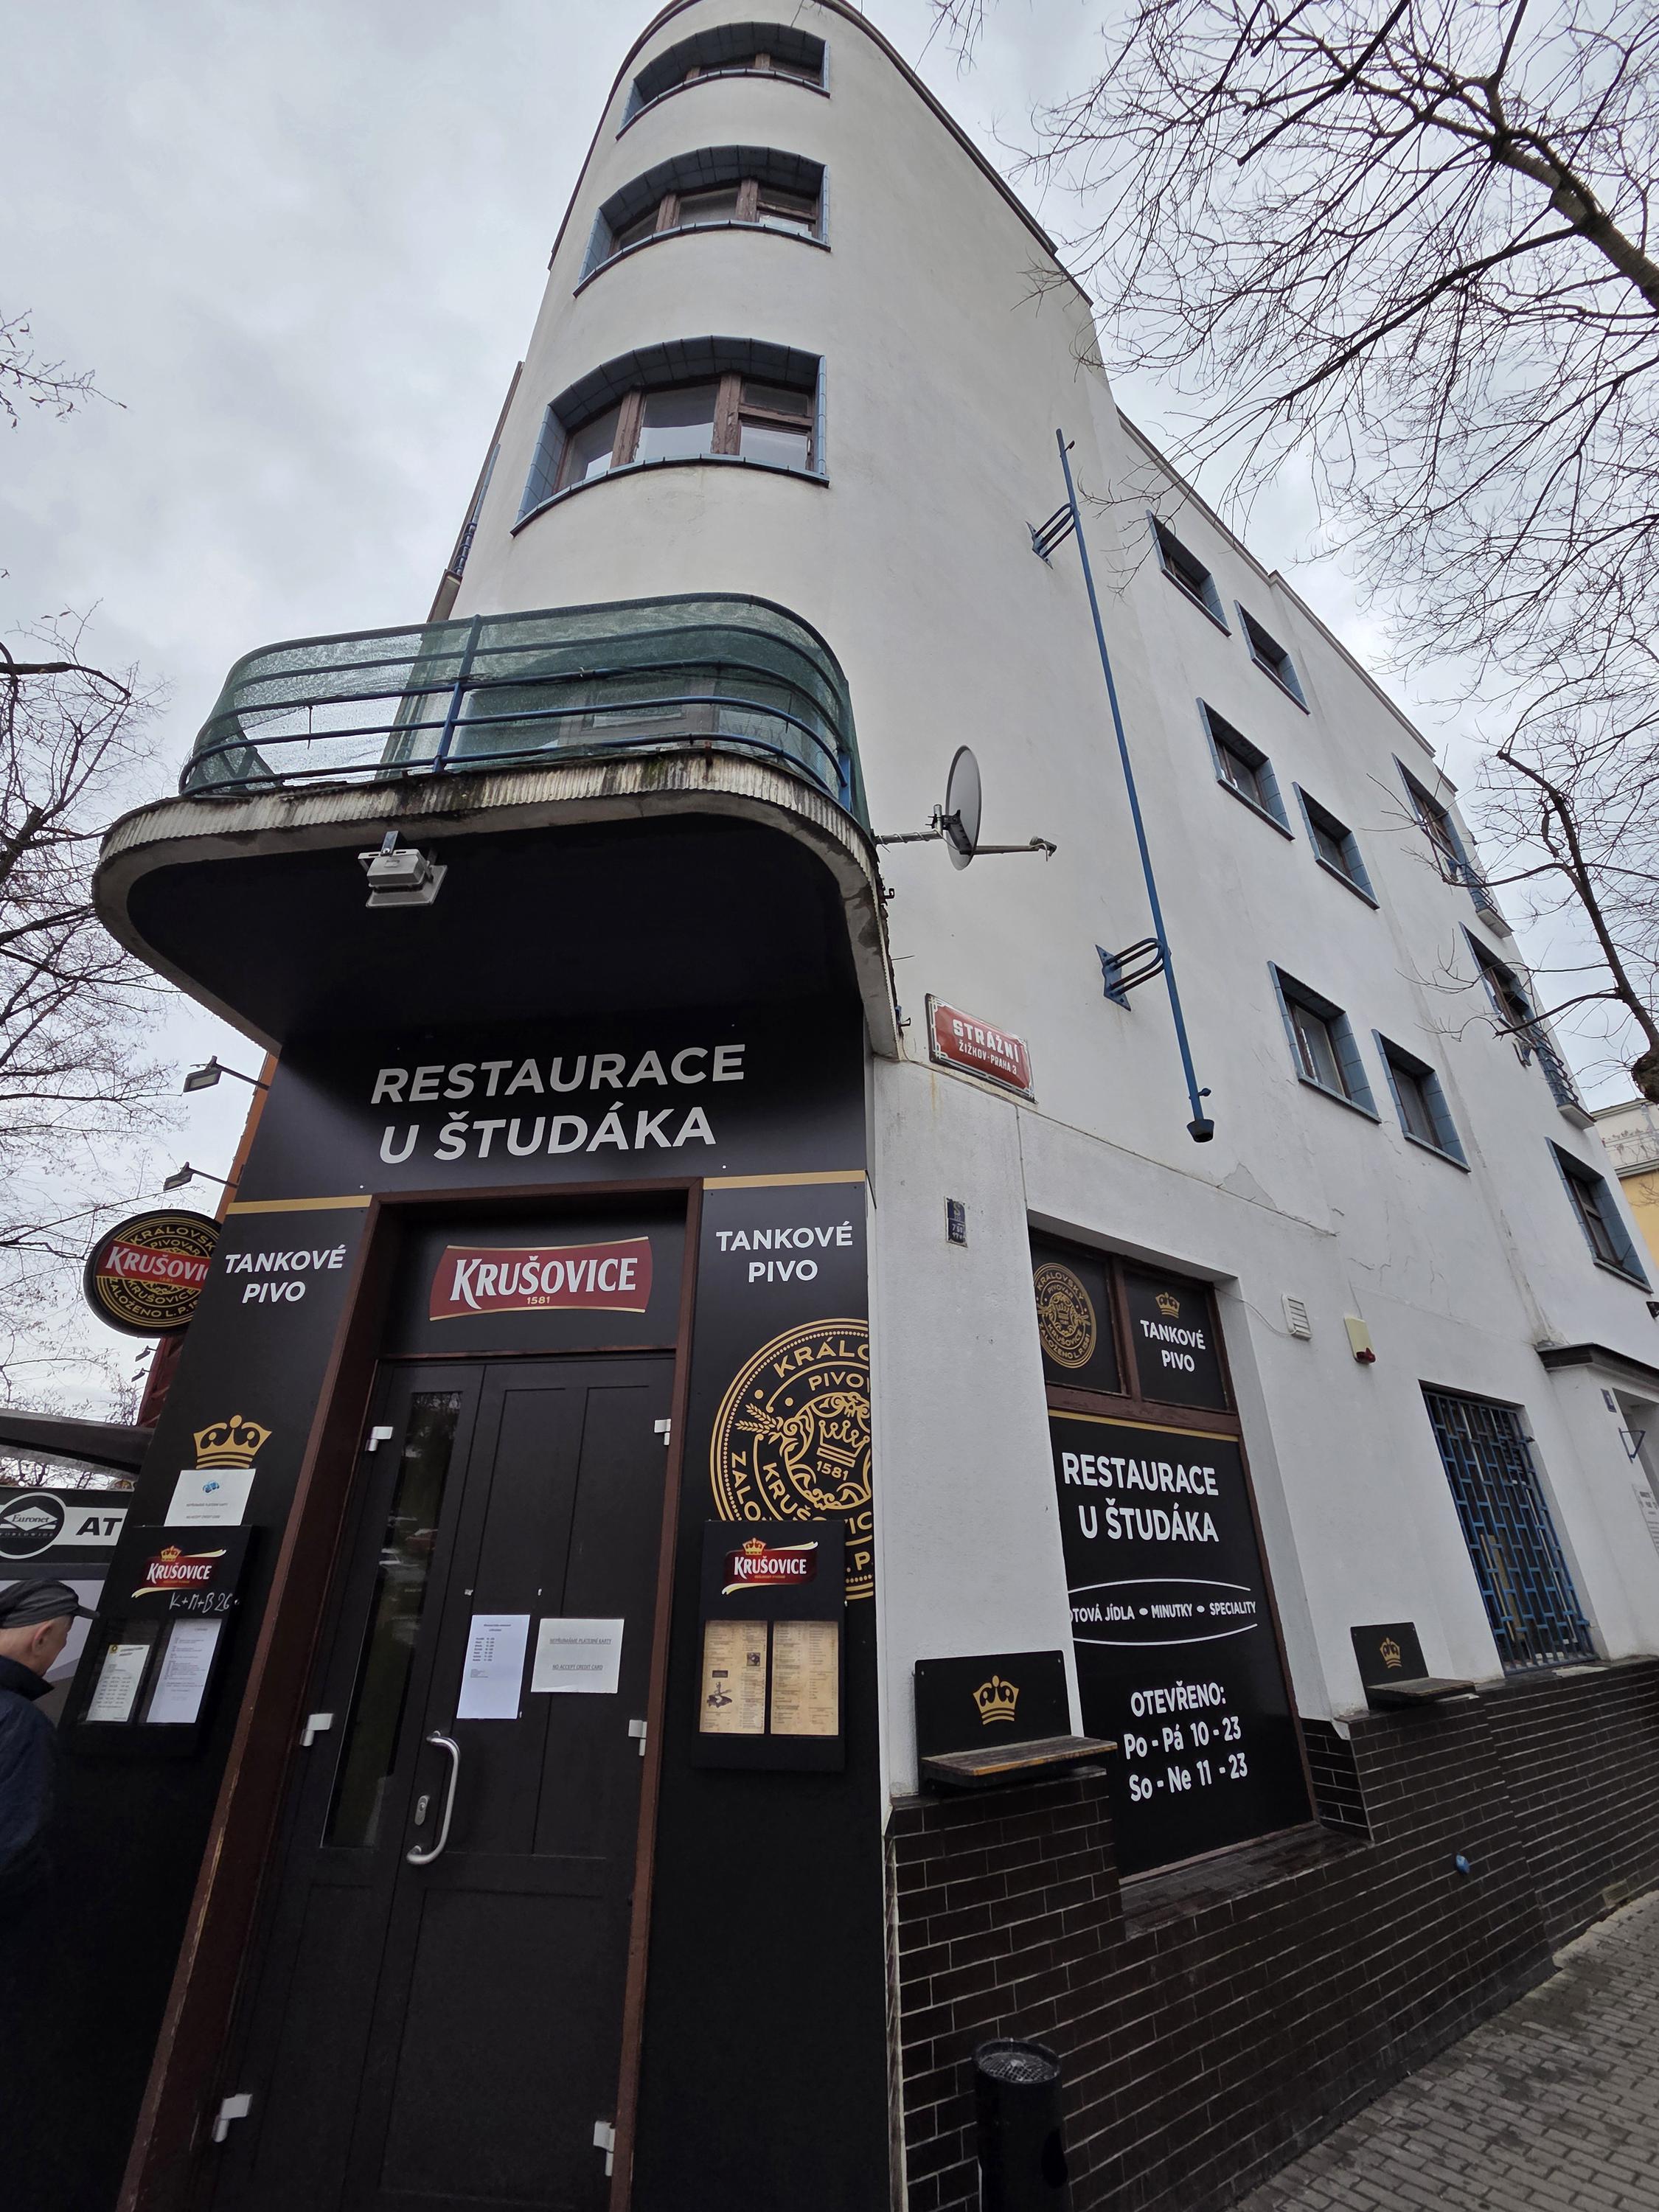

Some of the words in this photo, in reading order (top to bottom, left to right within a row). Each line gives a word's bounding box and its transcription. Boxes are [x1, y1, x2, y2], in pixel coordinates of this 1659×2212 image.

[953, 1019, 1019, 1063] STRÁŽNÍ
[371, 1044, 745, 1104] RESTAURACE
[380, 1124, 420, 1164] U
[434, 1102, 716, 1161] ŠTUDÁKA
[150, 1239, 201, 1256] PIVOVAR
[716, 1220, 853, 1251] TANKOVÉ
[105, 1246, 209, 1281] KRUŠOVI
[225, 1244, 347, 1273] TANKOVÉ
[748, 1259, 818, 1283] PIVO
[128, 1280, 196, 1304] KRUŠOVICE
[242, 1281, 306, 1304] PIVO
[449, 1255, 638, 1310] KRUŠOVICE
[1037, 1270, 1084, 1299] KRÁLOVSKÝ
[1047, 1284, 1074, 1298] PIVOVAR
[526, 1295, 551, 1304] 1581
[1048, 1324, 1082, 1347] KRUŠOVICE
[1140, 1320, 1206, 1350] TANKOVÉ
[1161, 1349, 1195, 1372] PIVO
[808, 1371, 871, 1391] PIVO
[817, 1461, 849, 1481] 1581
[1062, 1453, 1219, 1496] RESTAURACE
[12, 1514, 50, 1523] Euronet
[1078, 1505, 1098, 1539] U
[1105, 1498, 1220, 1542] ŠTUDÁKA
[147, 1562, 212, 1585] KRUŠOVICE
[734, 1556, 807, 1579] KRUŠOVICE
[1105, 1604, 1135, 1621] JÍDLA
[1151, 1604, 1193, 1619] MINUTKY
[1209, 1601, 1256, 1615] SPECIALITY
[1130, 1680, 1226, 1717] OTEVŘENO:
[1124, 1733, 1147, 1760] Po
[1162, 1724, 1184, 1753] Pá
[1190, 1722, 1209, 1747] 10
[1222, 1716, 1242, 1742] 23
[1129, 1774, 1152, 1801] So
[1167, 1766, 1192, 1793] Ne
[1196, 1760, 1211, 1787] 11
[1228, 1753, 1248, 1779] 23
